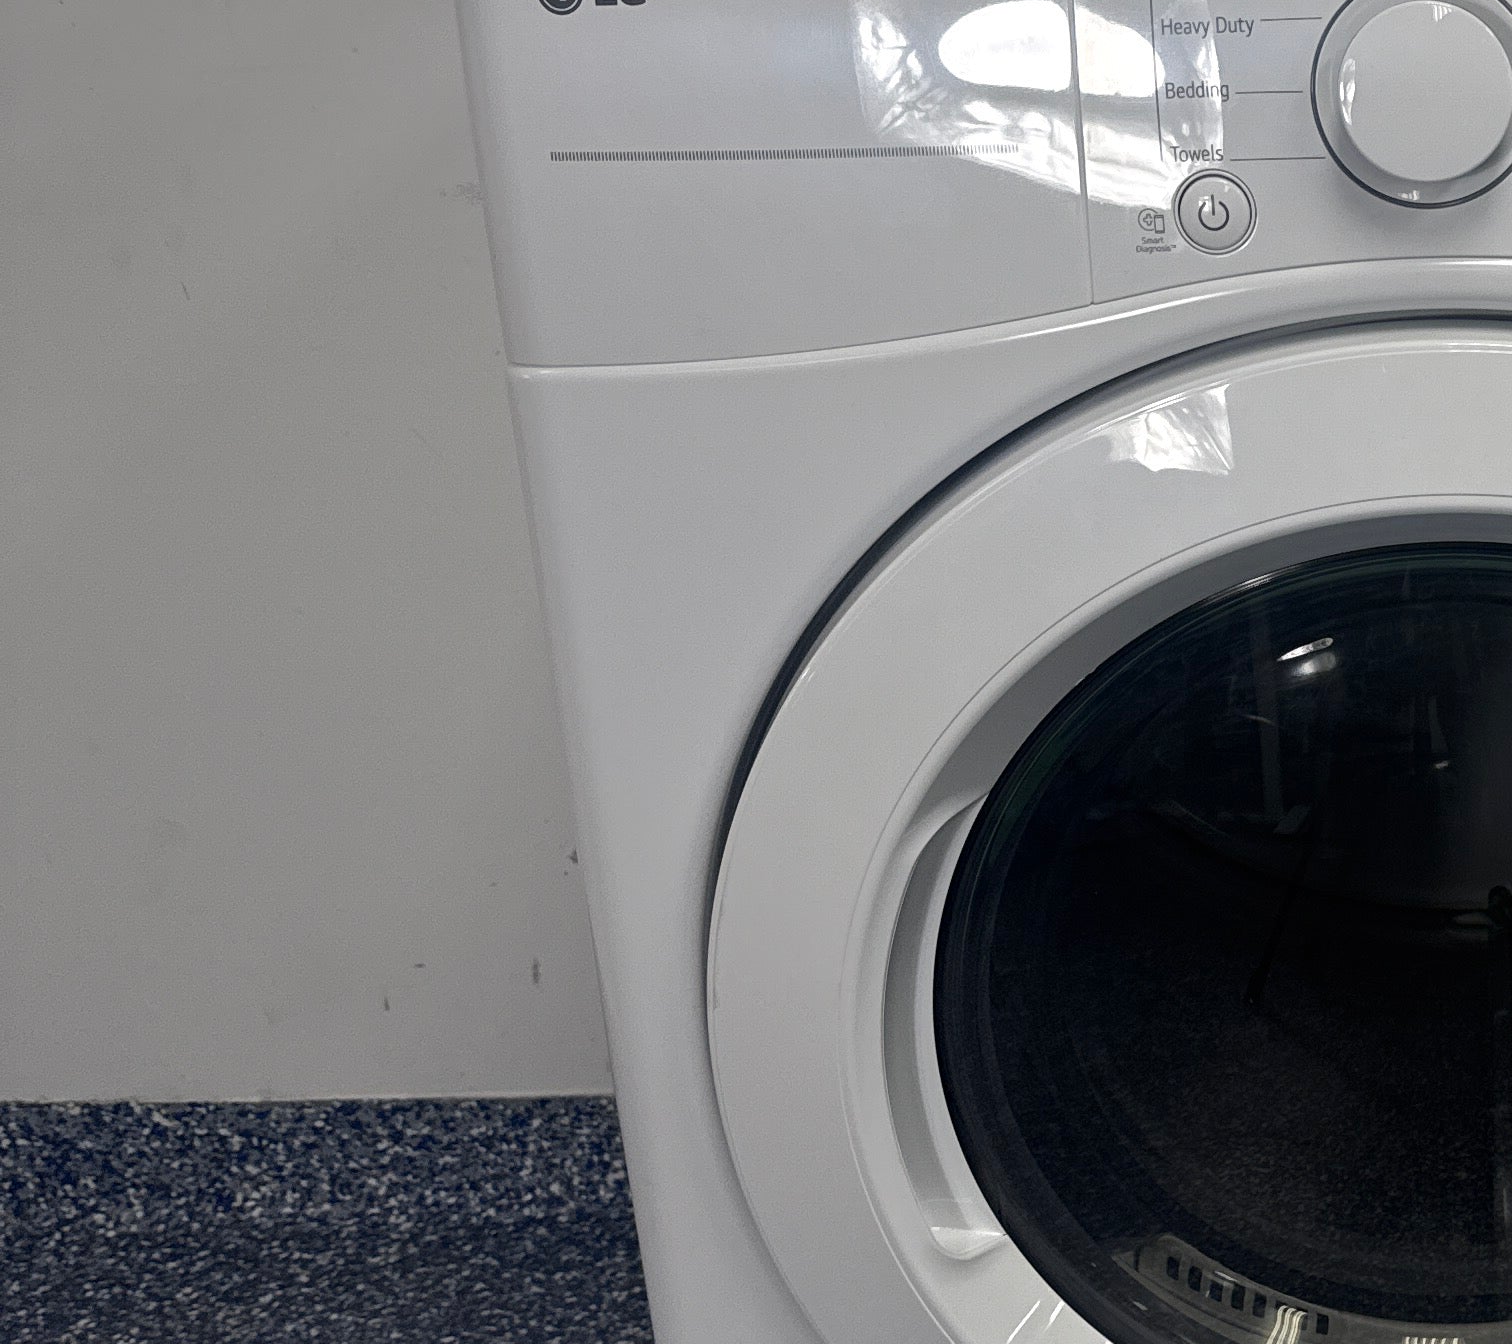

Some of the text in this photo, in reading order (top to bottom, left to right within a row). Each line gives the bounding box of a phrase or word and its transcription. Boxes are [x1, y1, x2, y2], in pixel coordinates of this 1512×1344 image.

[1160, 16, 1255, 39] Heavy Duty
[1164, 80, 1230, 102] Bedding
[1169, 143, 1224, 163] Towels
